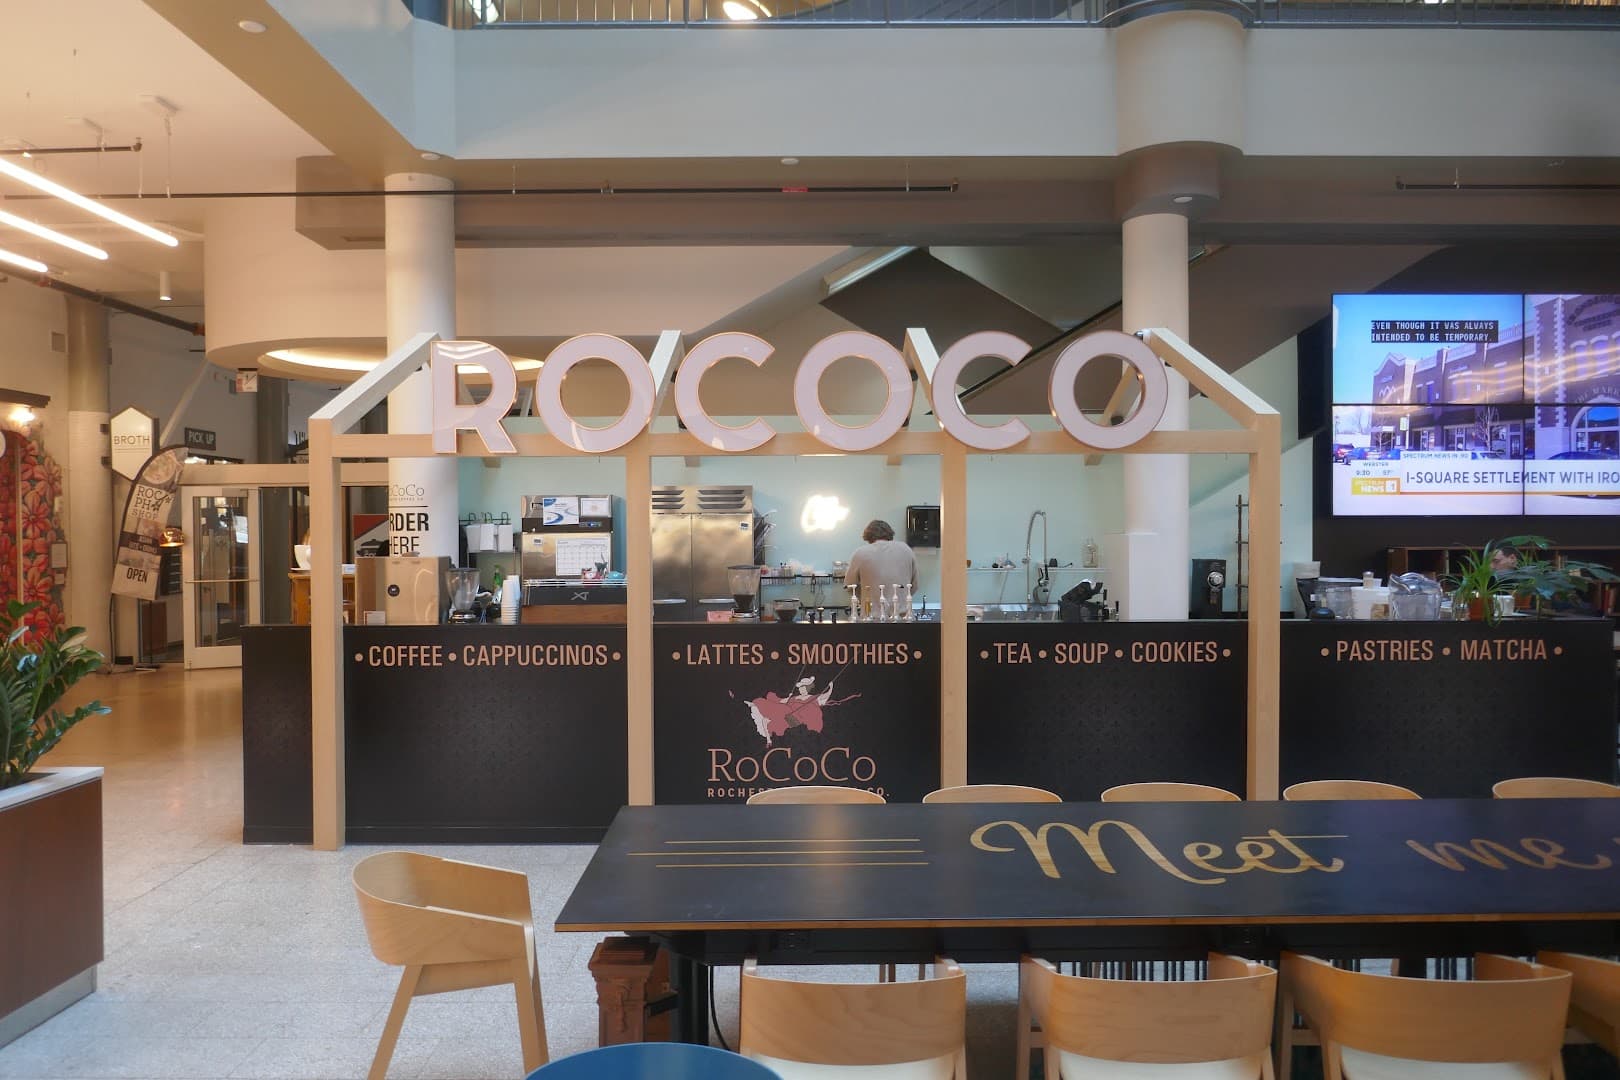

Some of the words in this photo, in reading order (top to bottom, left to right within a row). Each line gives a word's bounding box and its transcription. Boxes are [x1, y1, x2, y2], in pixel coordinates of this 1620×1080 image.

[1396, 322, 1425, 330] THOUGH
[1430, 322, 1439, 330] IT
[1444, 322, 1460, 330] WAS
[1464, 322, 1494, 330] ALWAYS
[1372, 333, 1411, 341] INTENDED
[1415, 333, 1425, 341] TO
[1430, 333, 1440, 341] BE
[430, 330, 1169, 455] ROCOCO
[113, 435, 150, 445] BROTH
[188, 430, 204, 443] PICK
[206, 433, 215, 445] UP
[1406, 471, 1470, 484] I-SQUARE
[1473, 471, 1556, 484] SETTLEMENT
[1559, 471, 1593, 484] WITH
[390, 484, 425, 496] CoCo
[132, 509, 158, 520] SHOP
[389, 513, 430, 532] RDER
[126, 567, 148, 583] OPEN
[368, 645, 443, 666] COFFEE
[462, 644, 608, 666] CAPPUCCINOS
[687, 643, 764, 665] LATTES
[787, 643, 909, 665] SMOOTHIES
[993, 642, 1033, 664] TEA
[1054, 642, 1109, 664] SOUP
[1131, 641, 1218, 663] COOKIES
[1336, 640, 1434, 661] PASTRIES
[1460, 639, 1548, 661] MATCHA
[707, 747, 877, 782] RoCoCo
[970, 819, 1348, 885] Meet
